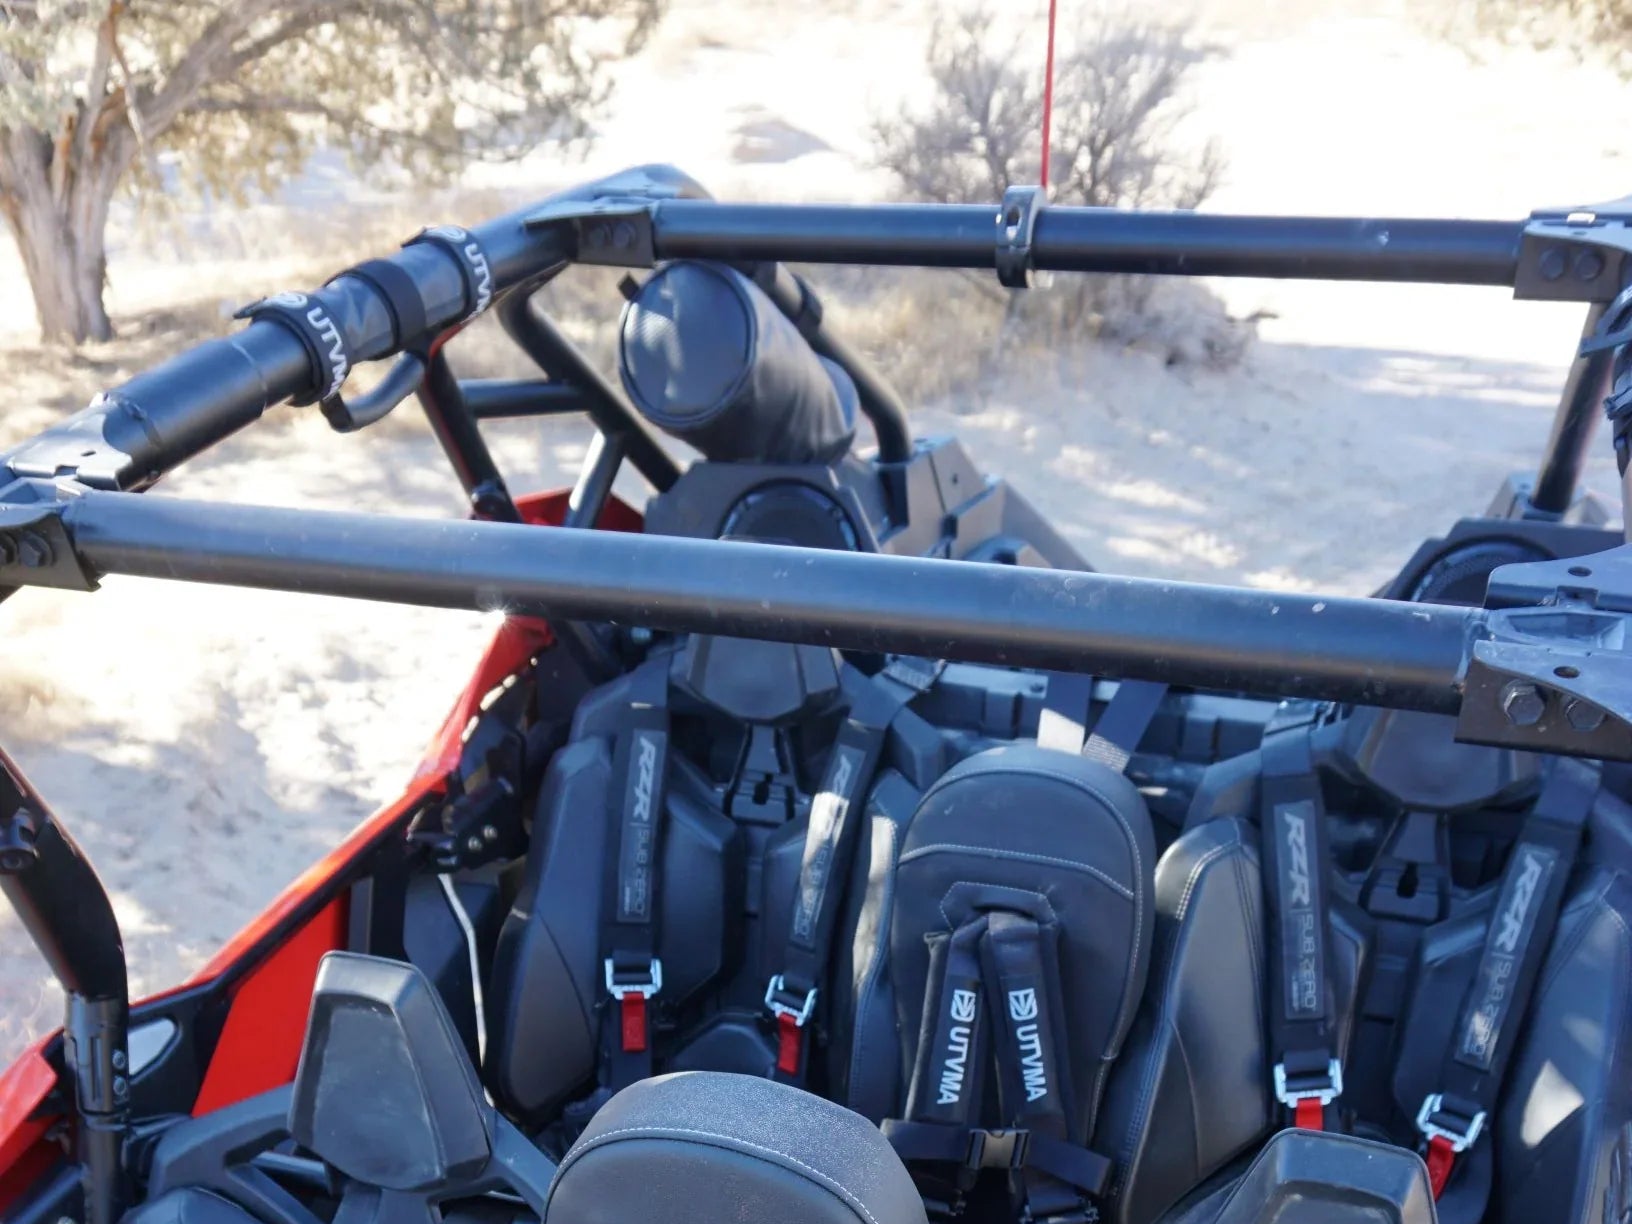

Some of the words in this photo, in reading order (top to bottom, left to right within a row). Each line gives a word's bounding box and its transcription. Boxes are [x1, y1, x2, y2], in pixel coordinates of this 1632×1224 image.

[307, 306, 347, 400] UTVM
[633, 736, 656, 822] RZR
[1284, 812, 1310, 905] RZR
[1494, 853, 1542, 953] RZR
[936, 1026, 971, 1105] UTVMA
[1016, 1023, 1048, 1102] UTVMA
